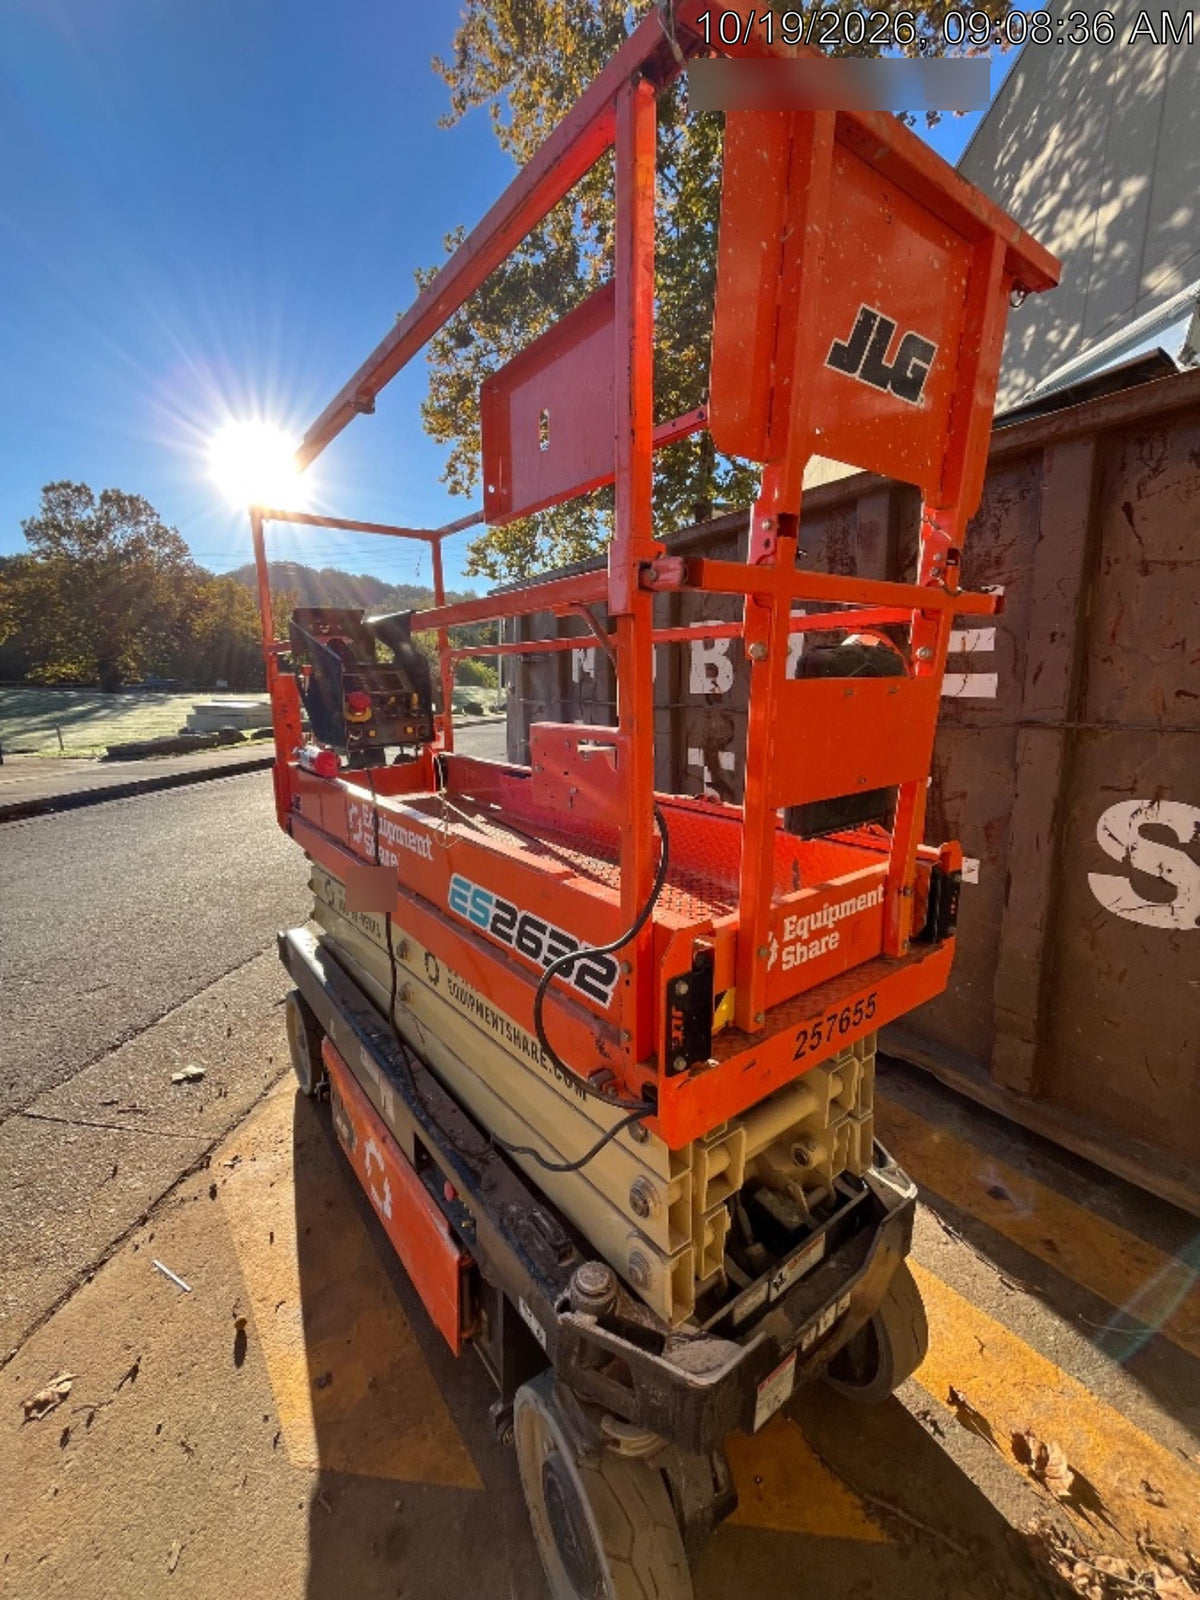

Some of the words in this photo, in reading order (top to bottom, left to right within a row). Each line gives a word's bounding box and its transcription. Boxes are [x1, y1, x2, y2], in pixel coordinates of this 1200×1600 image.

[824, 303, 939, 407] JLG
[448, 872, 621, 1011] ES2632
[782, 883, 885, 943] Equipment
[781, 931, 840, 972] Share
[792, 992, 878, 1062] 257655
